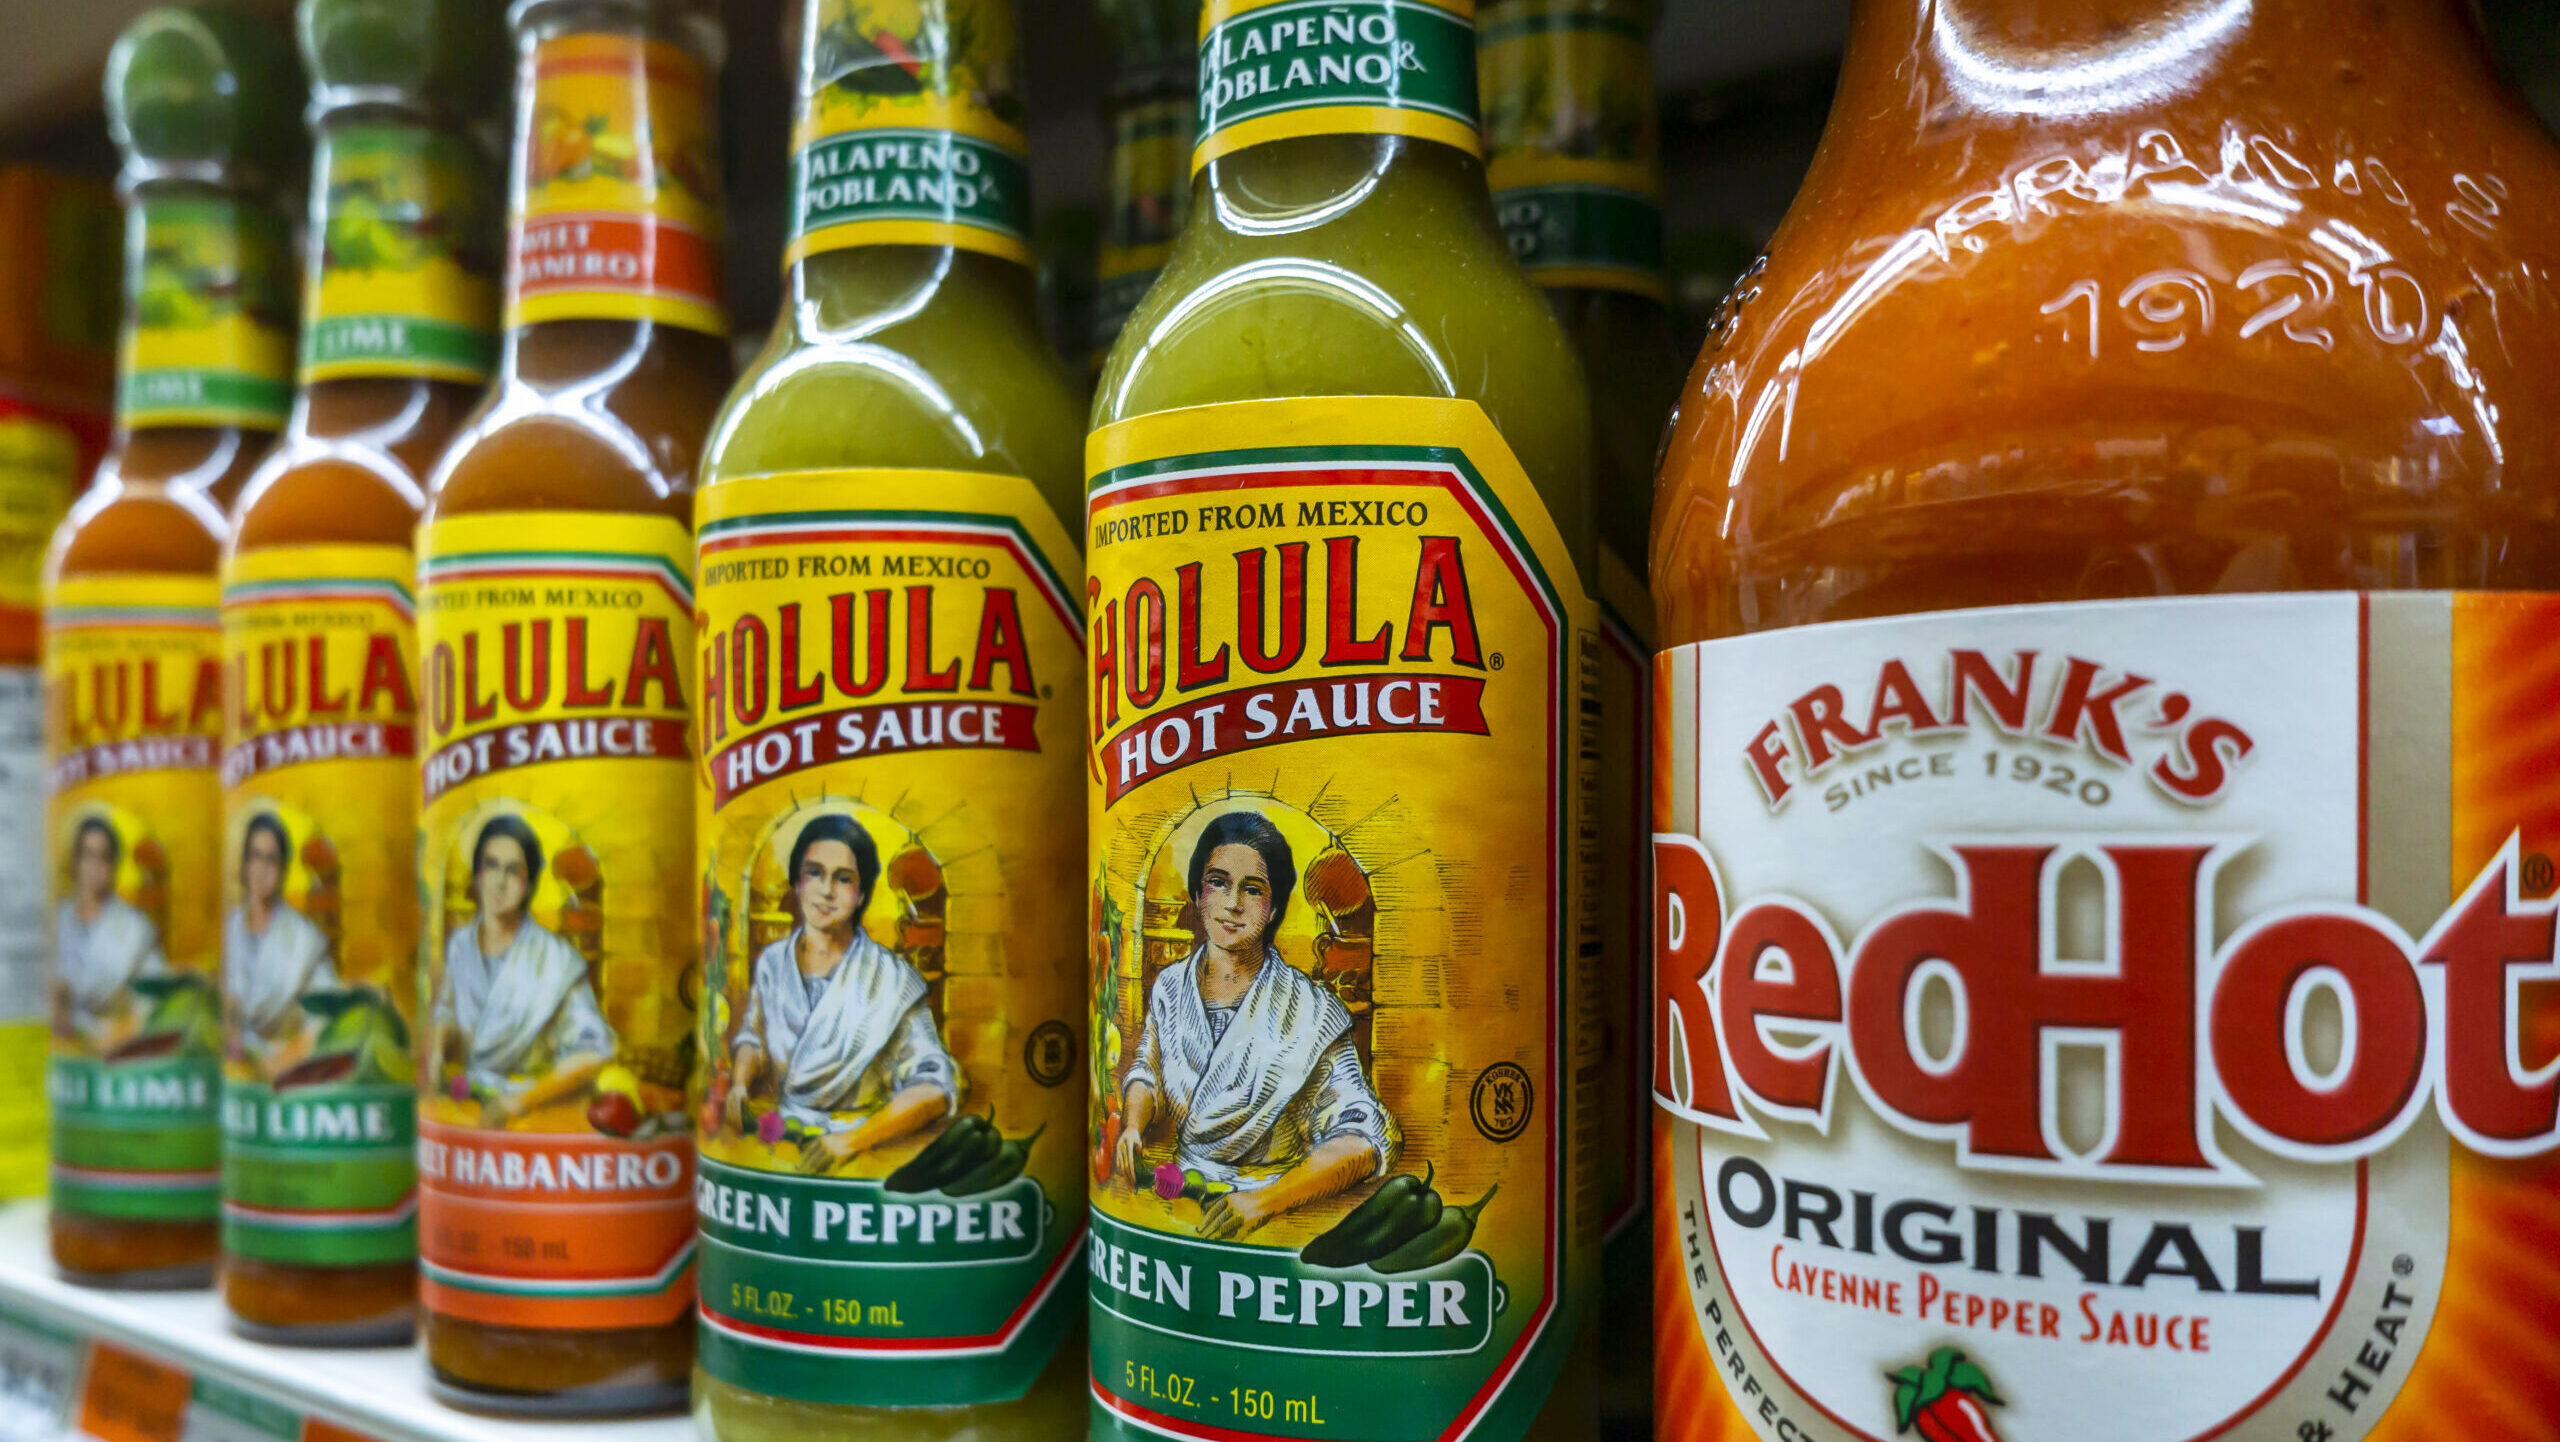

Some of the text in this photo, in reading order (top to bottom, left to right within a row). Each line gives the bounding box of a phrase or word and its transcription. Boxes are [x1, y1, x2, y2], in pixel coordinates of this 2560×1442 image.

[1200, 54, 1392, 121] POBLANO
[806, 140, 980, 182] ALAPEÑO
[2040, 261, 2428, 358] 1920
[1095, 501, 1428, 549] IMPORTED FROM MEXICO
[545, 588, 645, 609] MEXICO
[705, 556, 991, 587] IMPORTED FROM MEXICO
[727, 706, 1006, 791] HOT SAUCE
[1119, 681, 1445, 786] HOT SAUCE
[1745, 648, 2254, 804] FRANK'S
[426, 718, 657, 797] HOT SAUCE
[1824, 752, 2112, 811] SINCE 1920
[266, 1100, 393, 1143] LIME
[453, 1145, 684, 1191] HABANERO
[812, 1200, 1025, 1245] PEPPER
[1683, 1200, 1708, 1289] THE
[1716, 1155, 2321, 1302] ORIGINAL
[731, 1283, 742, 1309] 5
[823, 1299, 861, 1326] 150
[869, 1302, 905, 1327] mL
[1218, 1270, 1472, 1328] PEPPER
[1771, 1243, 2211, 1353] CAYENNE PEPPER SAUCE
[1126, 1360, 1137, 1388] 5
[1230, 1390, 1274, 1419] 150
[1285, 1395, 1325, 1425] mL
